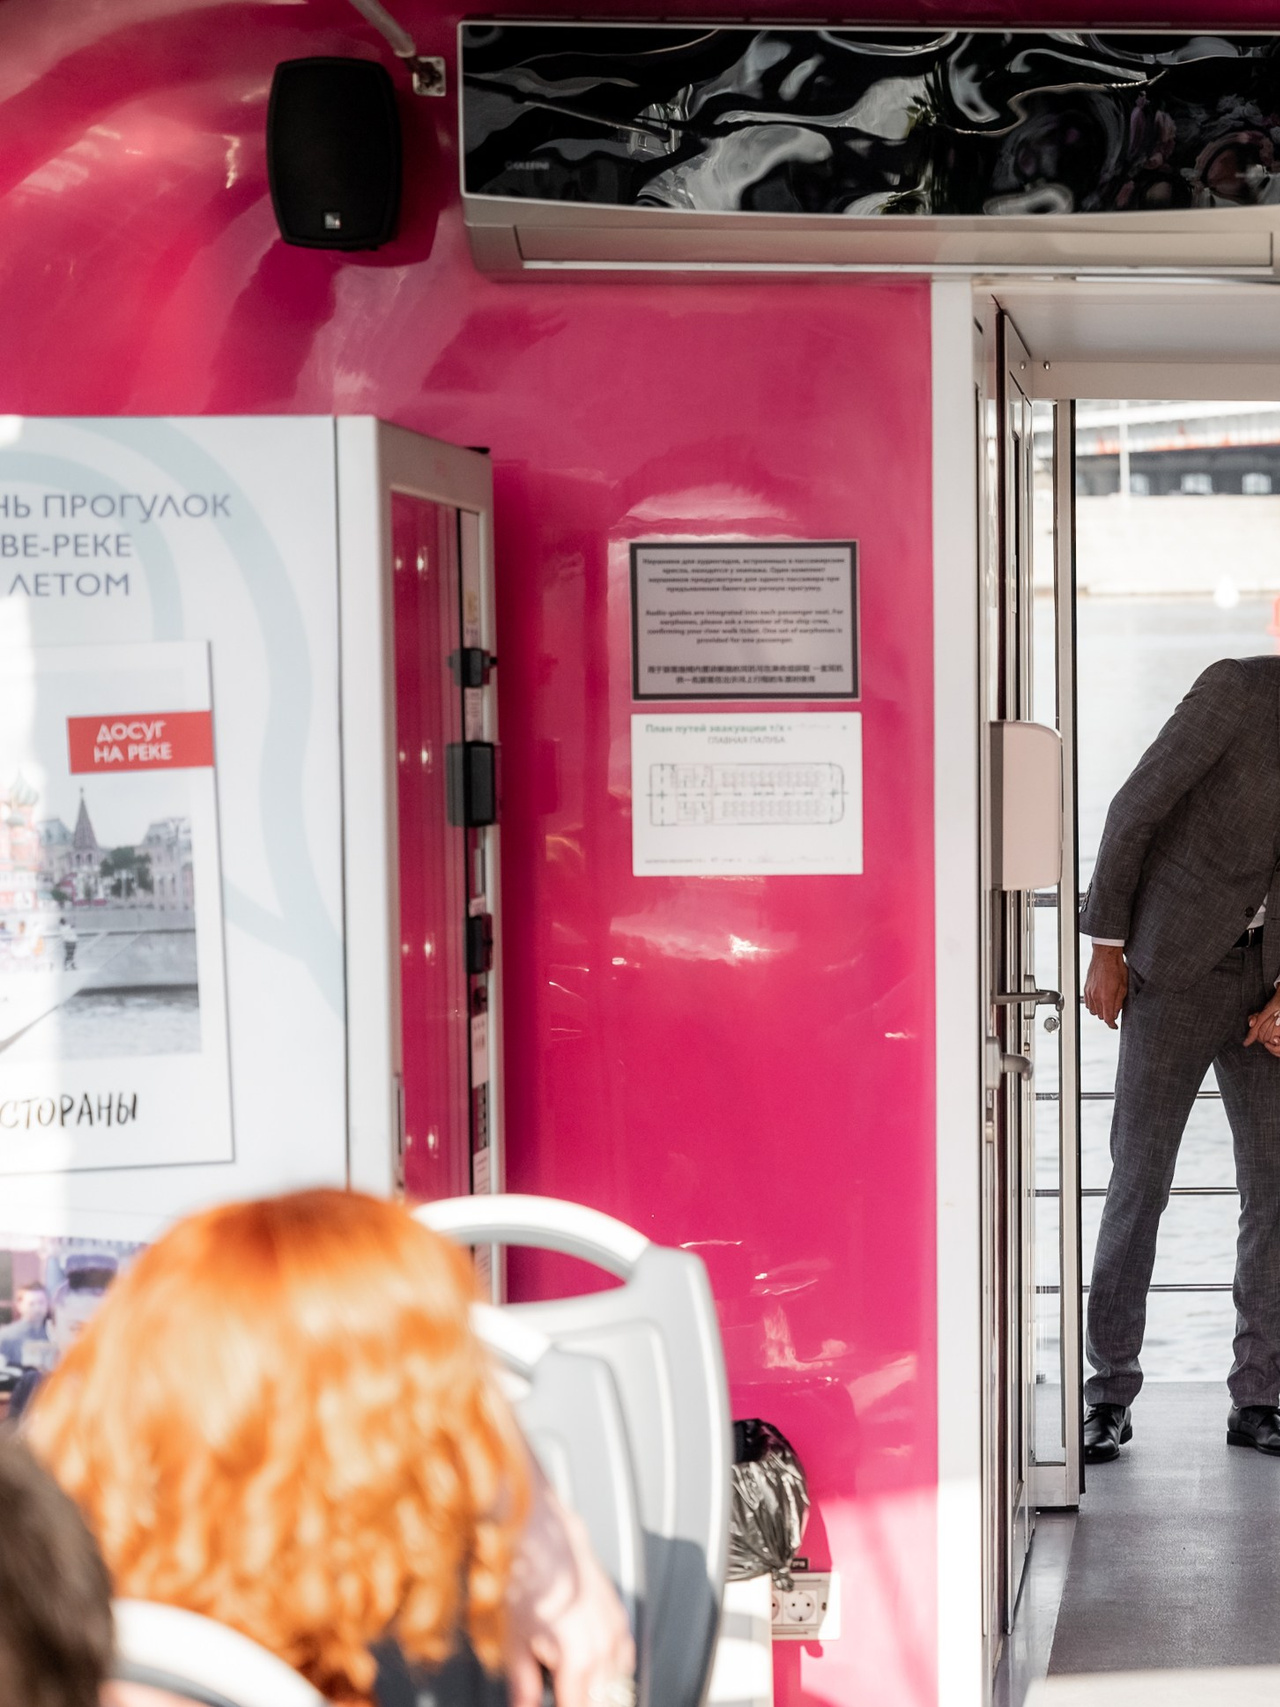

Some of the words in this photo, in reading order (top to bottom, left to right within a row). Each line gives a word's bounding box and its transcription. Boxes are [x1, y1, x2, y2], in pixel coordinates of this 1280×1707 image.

[43, 493, 233, 523] ПРОГУЛОК
[1, 533, 132, 558] ВЕ-РЕКЕ
[8, 572, 130, 597] ЛЕТОМ
[96, 719, 167, 743] ДОСУГ
[93, 744, 124, 764] НА
[127, 741, 173, 763] РЕКЕ
[0, 1091, 137, 1129] СТОРАНЫ
